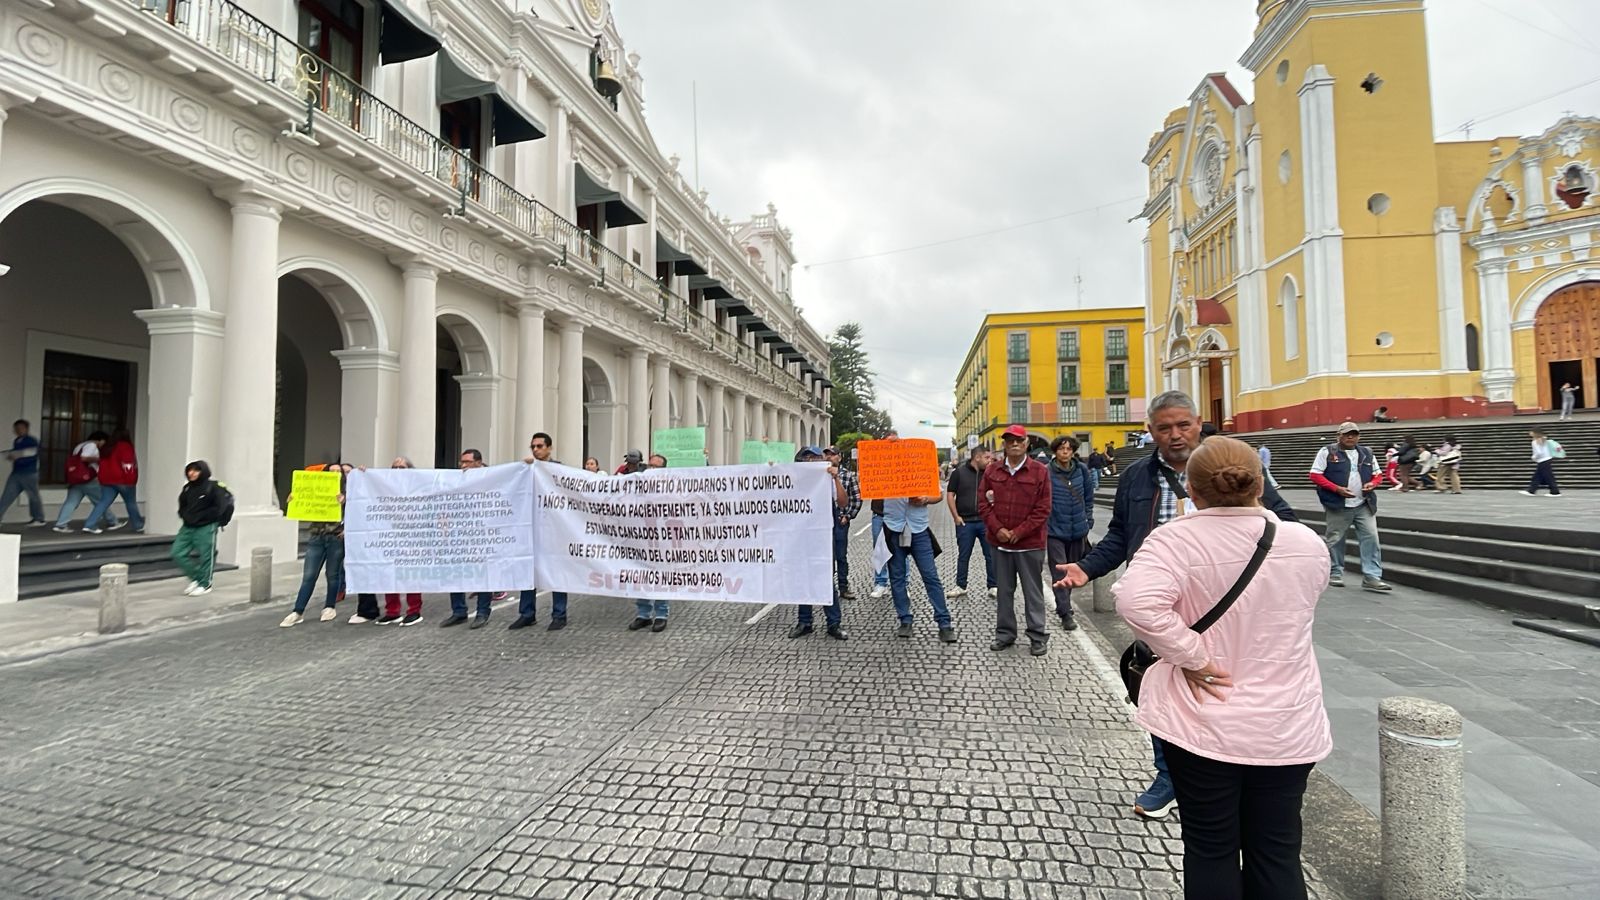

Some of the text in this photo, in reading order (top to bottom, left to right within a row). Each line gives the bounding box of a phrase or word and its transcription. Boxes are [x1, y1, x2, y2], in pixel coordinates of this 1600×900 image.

[598, 480, 608, 493] DE
[611, 480, 620, 494] LA
[623, 481, 633, 494] 4T
[635, 479, 675, 495] PROMETIO
[676, 477, 727, 494] AYUDARNOS
[730, 477, 735, 491] Y
[738, 476, 750, 491] NO
[752, 475, 794, 490] CUMPLIO.
[434, 501, 493, 511] INTEGRANTES
[495, 500, 513, 508] DEL
[543, 492, 566, 510] AÑOS
[589, 502, 627, 517] ESPERADO
[629, 502, 699, 519] PACIENTEMENTE,
[700, 502, 711, 516] YA
[714, 501, 732, 516] SON
[734, 500, 769, 515] LAUDOS
[771, 499, 813, 514] GANADOS.
[472, 509, 514, 518] NUESTRA
[456, 520, 474, 528] POR
[444, 530, 456, 538] DE
[458, 529, 486, 537] PAGOS
[488, 528, 501, 536] DE
[585, 521, 758, 540] ESTAMOS CANSADOS DE TANTA INJUSTICIA Y
[450, 538, 469, 546] CON
[471, 536, 517, 545] SERVICIOS
[433, 548, 479, 556] VERACRUZ
[569, 543, 776, 563] QUE ESTE GOBIERNO DEL CAMBIO SIGA SIN CUMPLIR.
[619, 569, 660, 585] EXIGIMOS
[661, 572, 699, 586] NUESTRO
